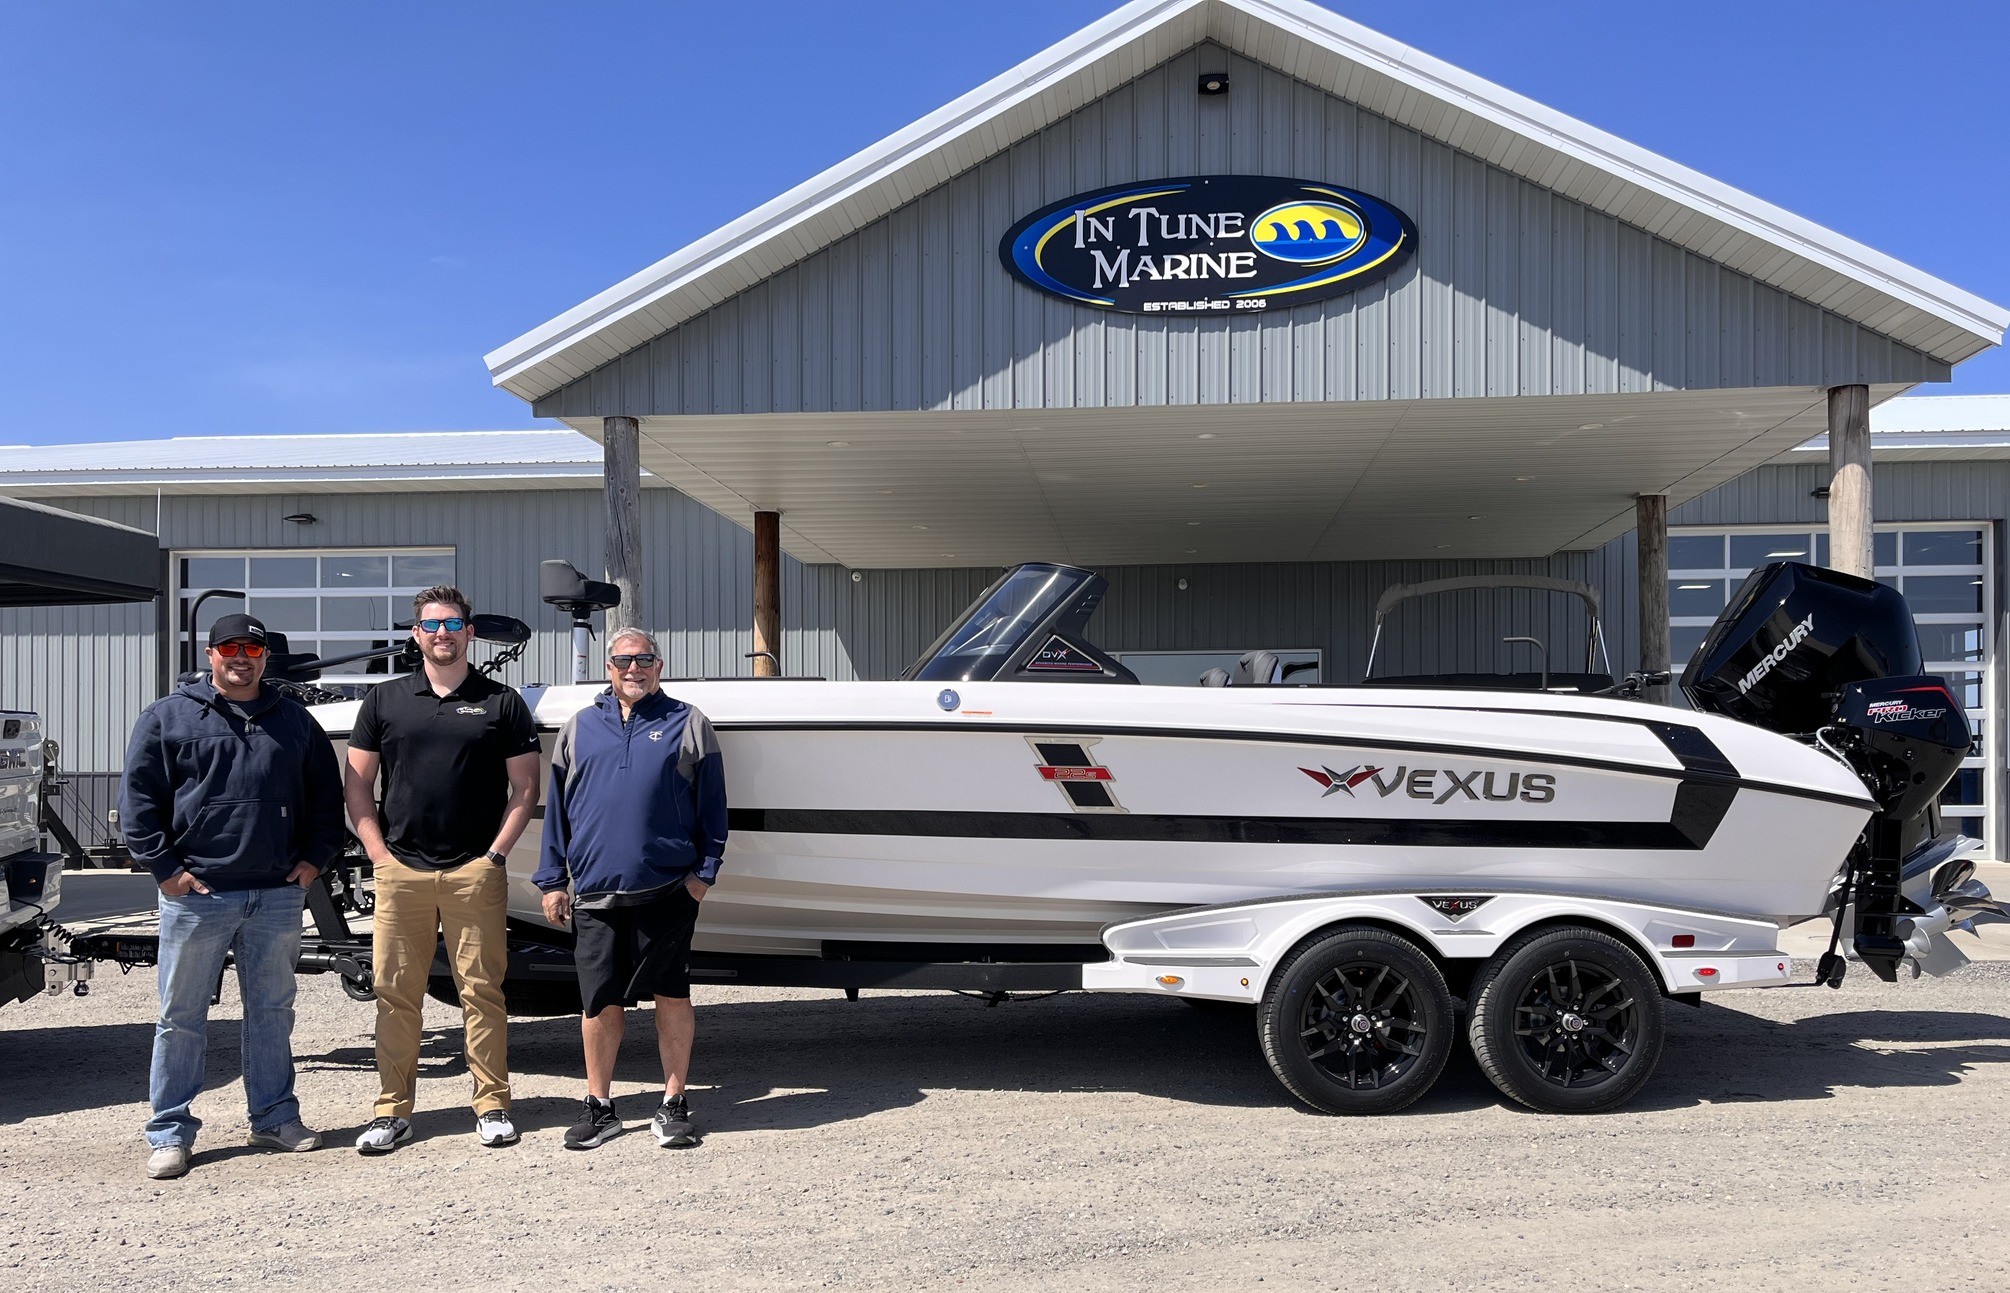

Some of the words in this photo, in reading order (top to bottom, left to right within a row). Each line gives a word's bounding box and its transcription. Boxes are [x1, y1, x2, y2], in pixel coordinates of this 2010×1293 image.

[1128, 206, 1247, 248] TUNE
[1089, 249, 1258, 289] MARINE
[1142, 299, 1231, 312] ESTABLISHED
[1042, 648, 1072, 661] DVX
[1737, 612, 1816, 695] MERCURY
[1868, 699, 1904, 708] MERCURY
[1363, 764, 1557, 805] VEXUS
[1431, 899, 1478, 911] VEXUS
